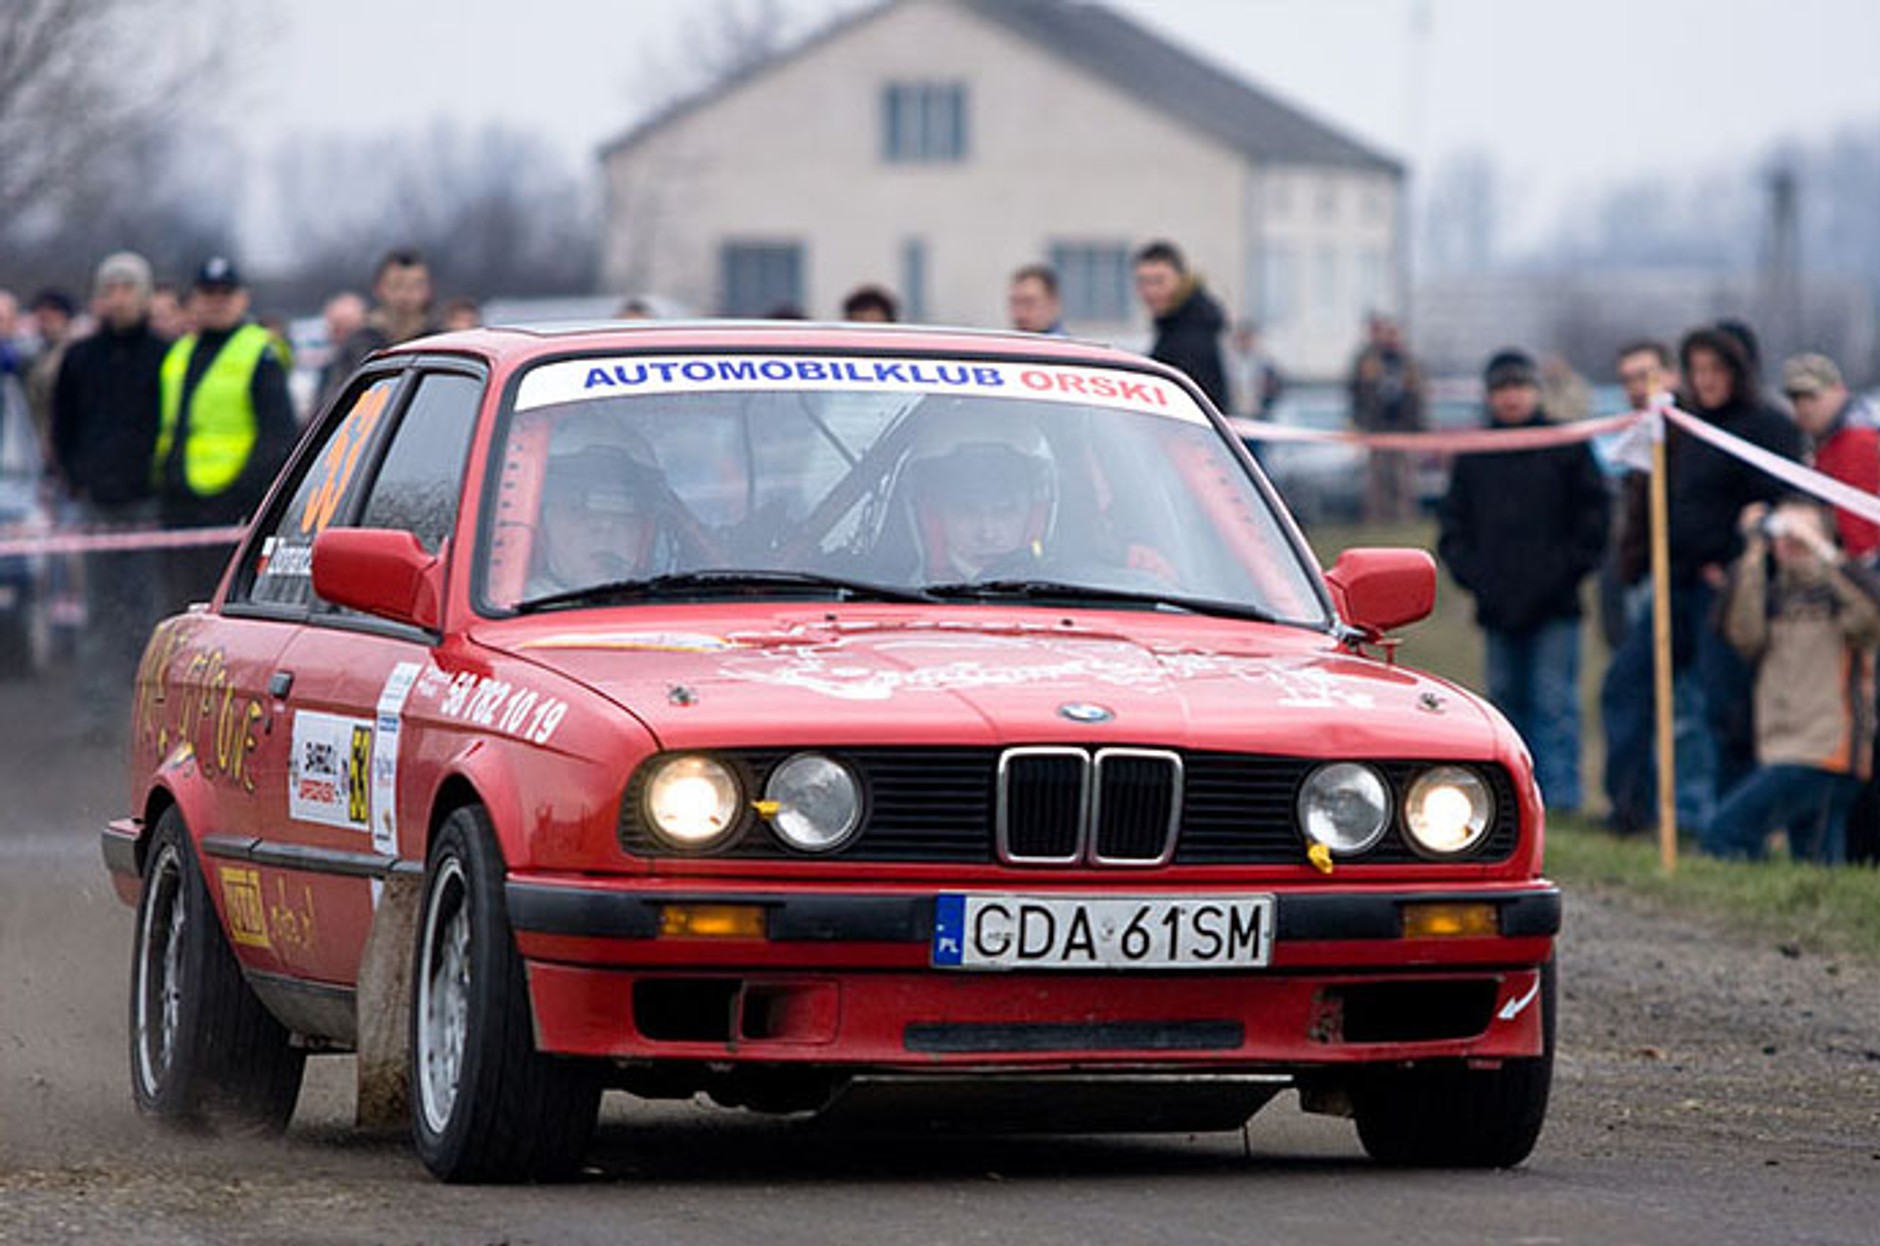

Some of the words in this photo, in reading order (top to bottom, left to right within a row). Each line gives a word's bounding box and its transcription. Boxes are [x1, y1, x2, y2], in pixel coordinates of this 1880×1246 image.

[583, 360, 1005, 388] AUTOMOBILKLUB
[1019, 370, 1168, 406] ORSKI
[499, 687, 538, 734] 10
[524, 697, 568, 745] 19
[1120, 904, 1263, 963] 61SM
